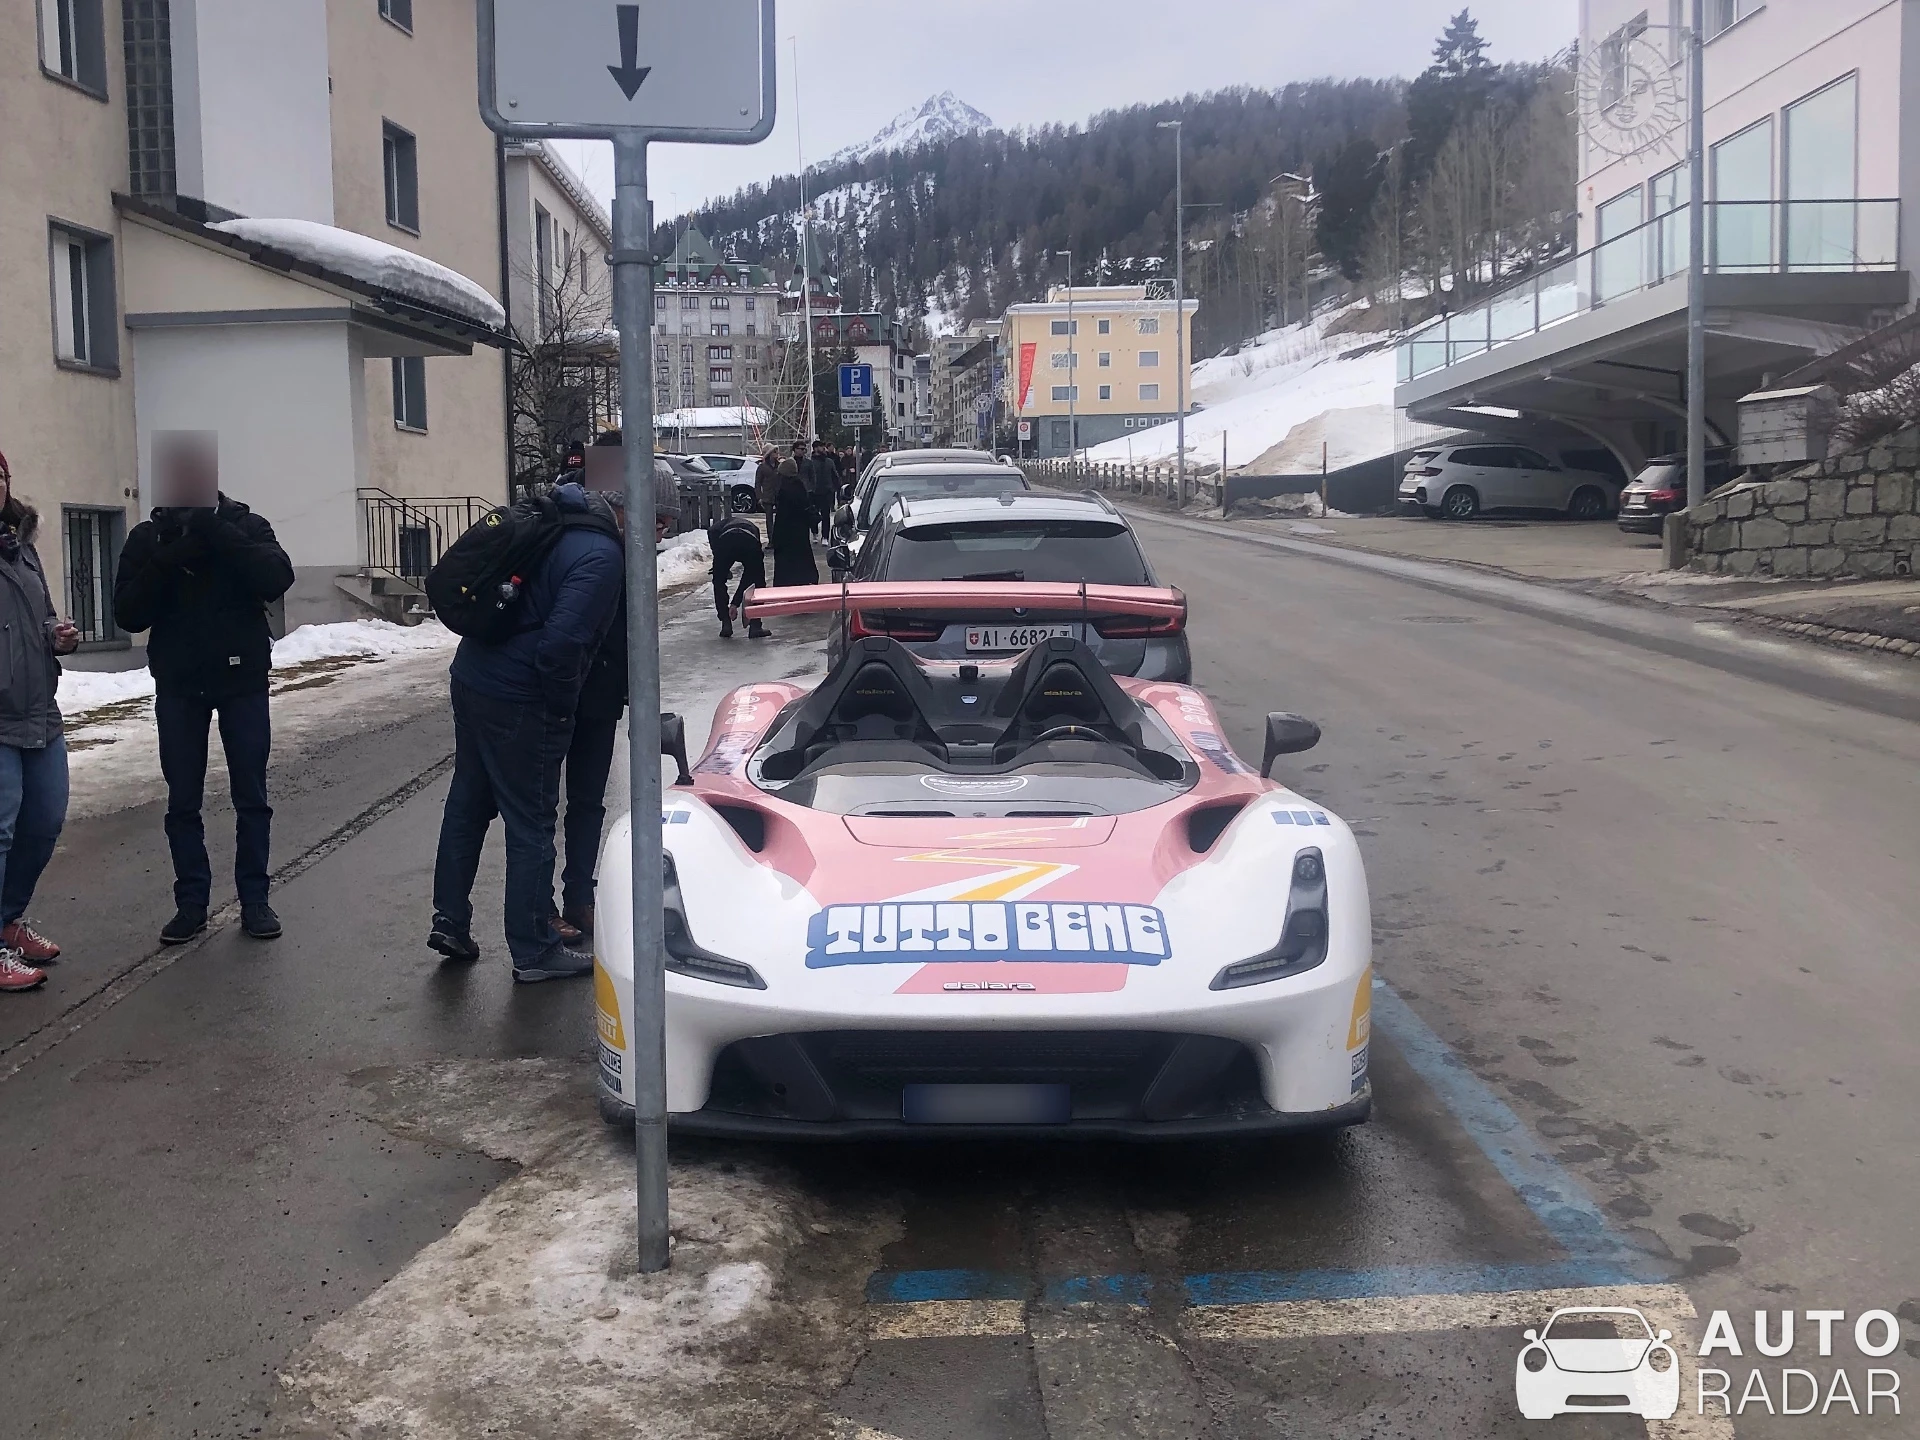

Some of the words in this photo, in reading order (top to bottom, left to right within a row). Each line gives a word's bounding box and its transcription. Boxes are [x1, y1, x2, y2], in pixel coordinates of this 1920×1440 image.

[850, 368, 861, 384] P
[824, 903, 1010, 955] TUTTO
[1014, 903, 1166, 956] BENE
[943, 981, 1037, 991] dallara
